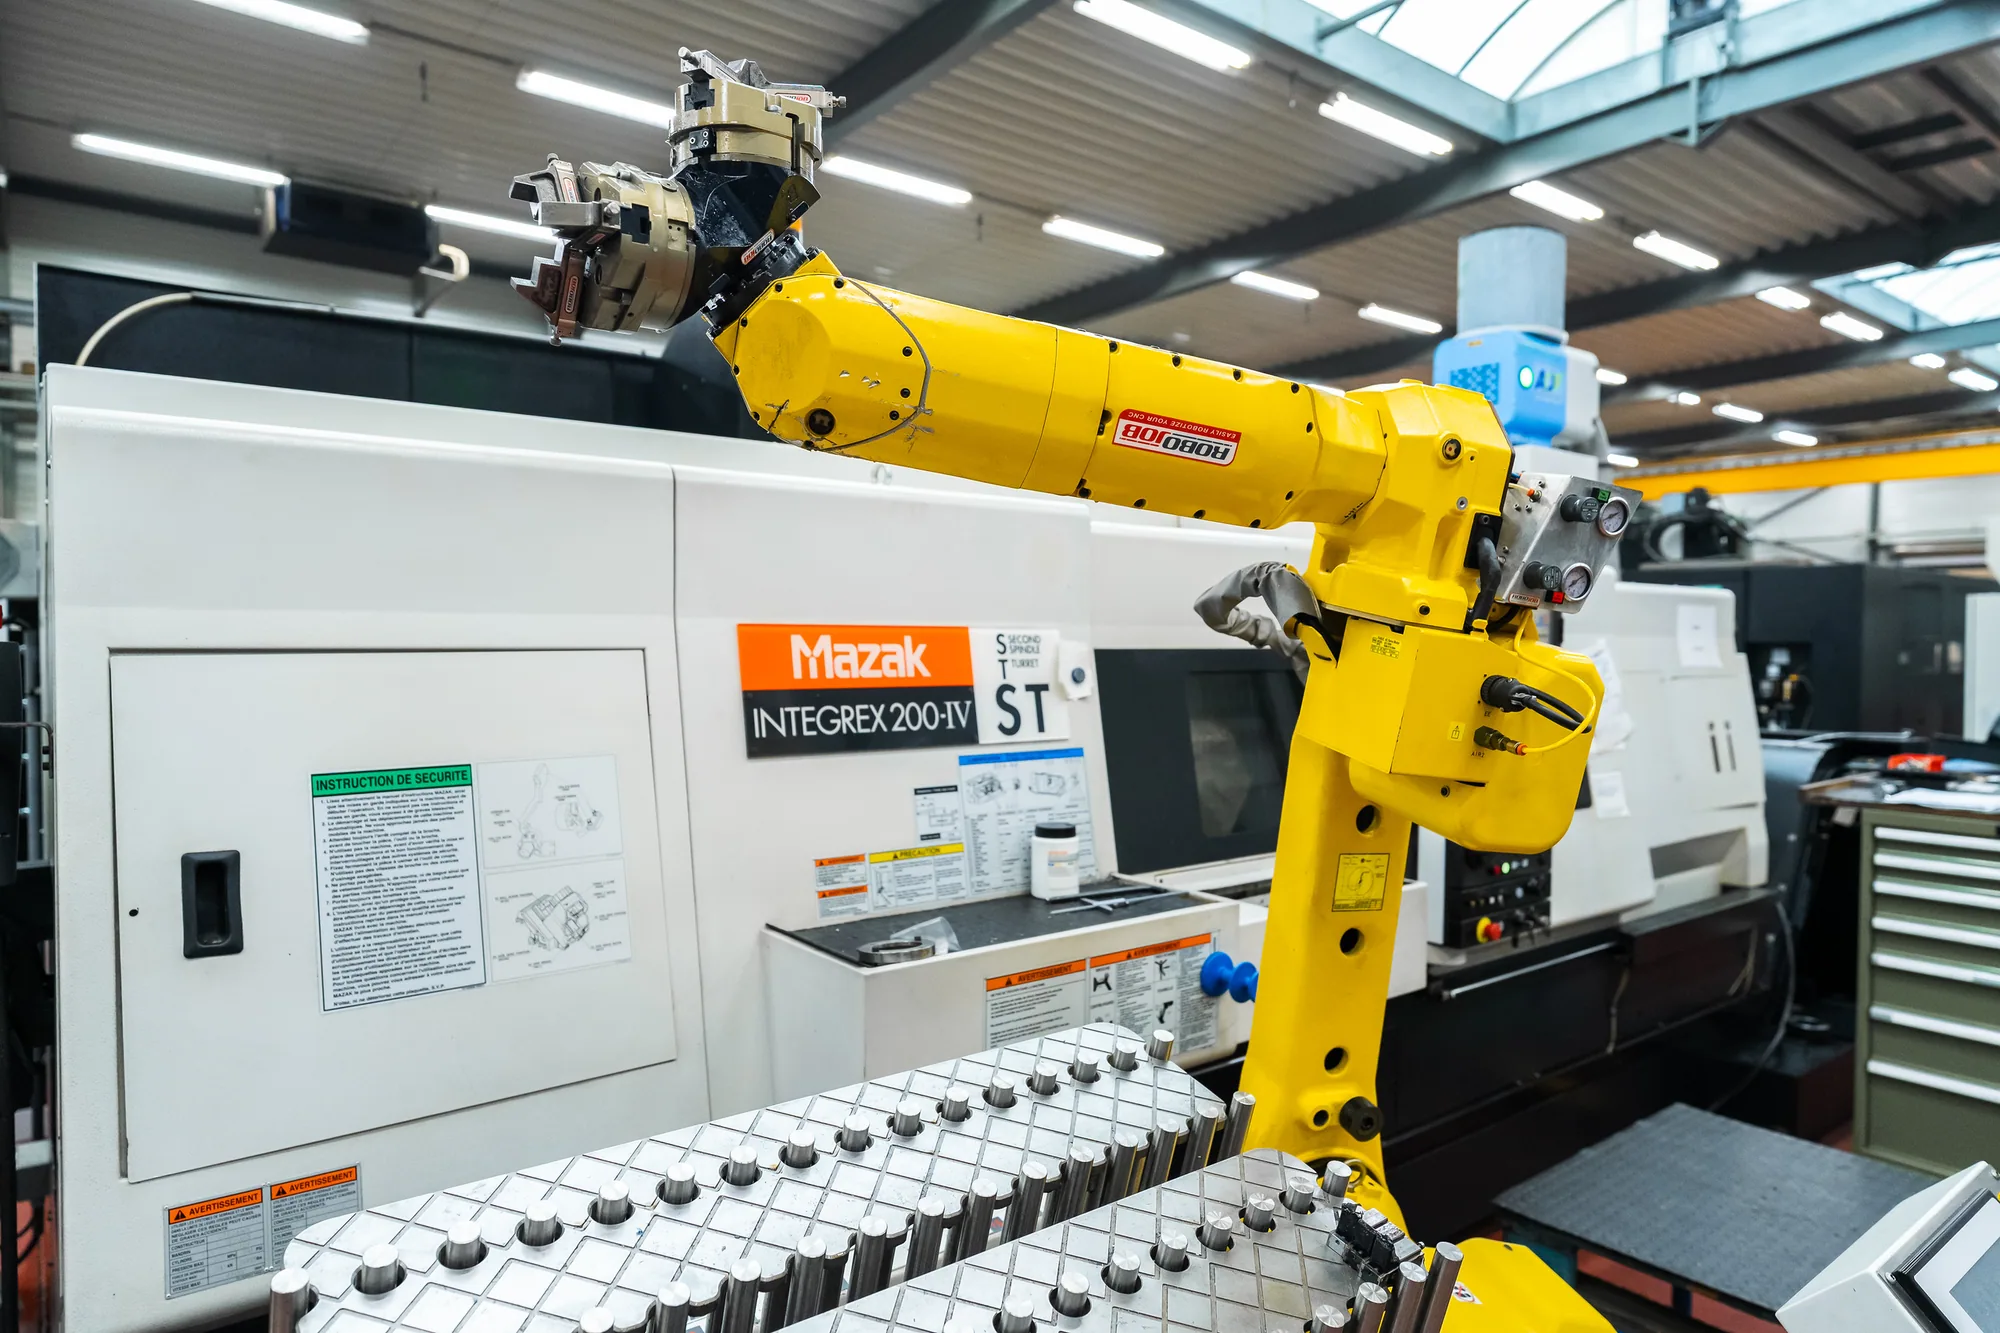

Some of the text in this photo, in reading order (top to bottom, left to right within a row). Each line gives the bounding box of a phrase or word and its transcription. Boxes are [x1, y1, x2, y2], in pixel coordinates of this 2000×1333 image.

[1128, 411, 1236, 439] EASILY ROBOTIZE YOUR CNC
[996, 634, 1041, 655] S SECOND
[790, 634, 932, 680] Mazak
[998, 659, 1008, 680] T
[753, 700, 972, 738] INTEGREX 200-IV
[996, 684, 1050, 736] ST
[316, 770, 468, 791] INSTRUCTION DE SECURITE
[289, 1171, 353, 1192] AVERTISSEMENT
[189, 1194, 258, 1216] AVERTISSEMENT
